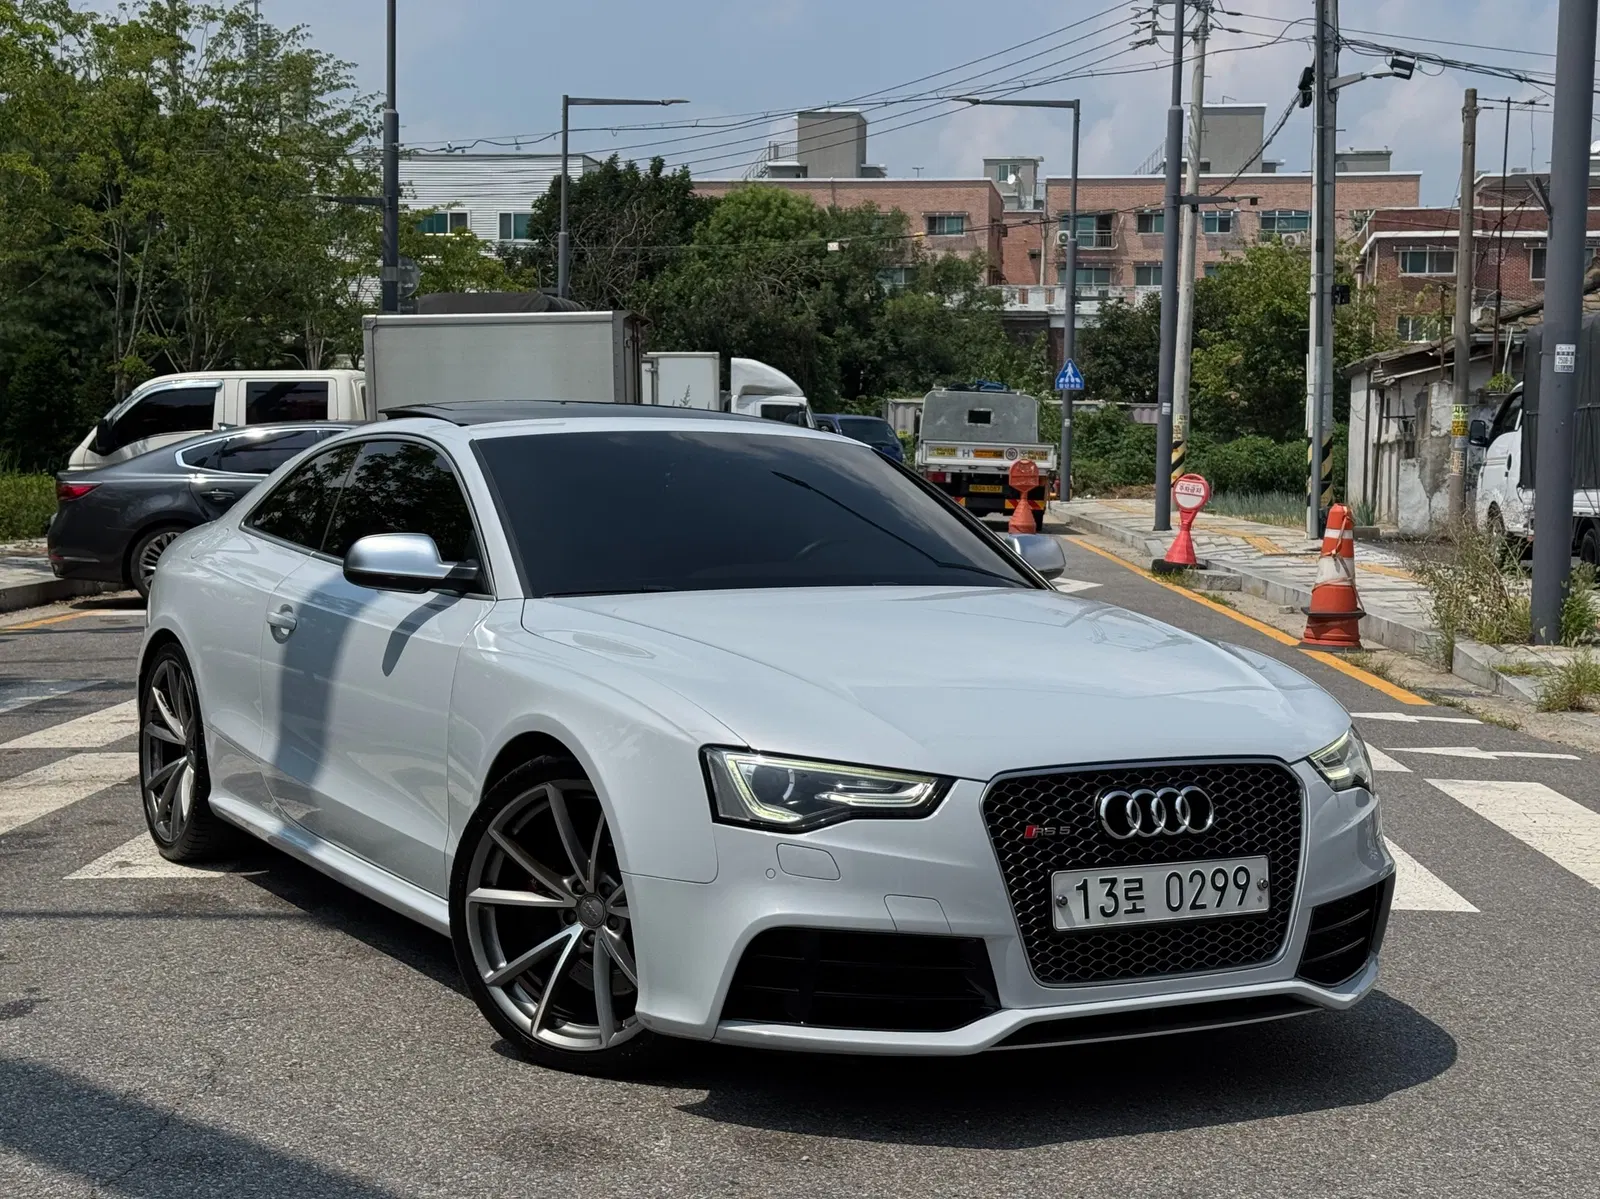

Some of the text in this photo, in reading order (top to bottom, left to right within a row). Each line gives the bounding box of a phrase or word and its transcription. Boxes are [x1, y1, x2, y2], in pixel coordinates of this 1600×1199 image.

[1179, 485, 1202, 494] 주차금지
[1032, 826, 1071, 837] RS 5
[1075, 865, 1251, 920] 13로 0299
